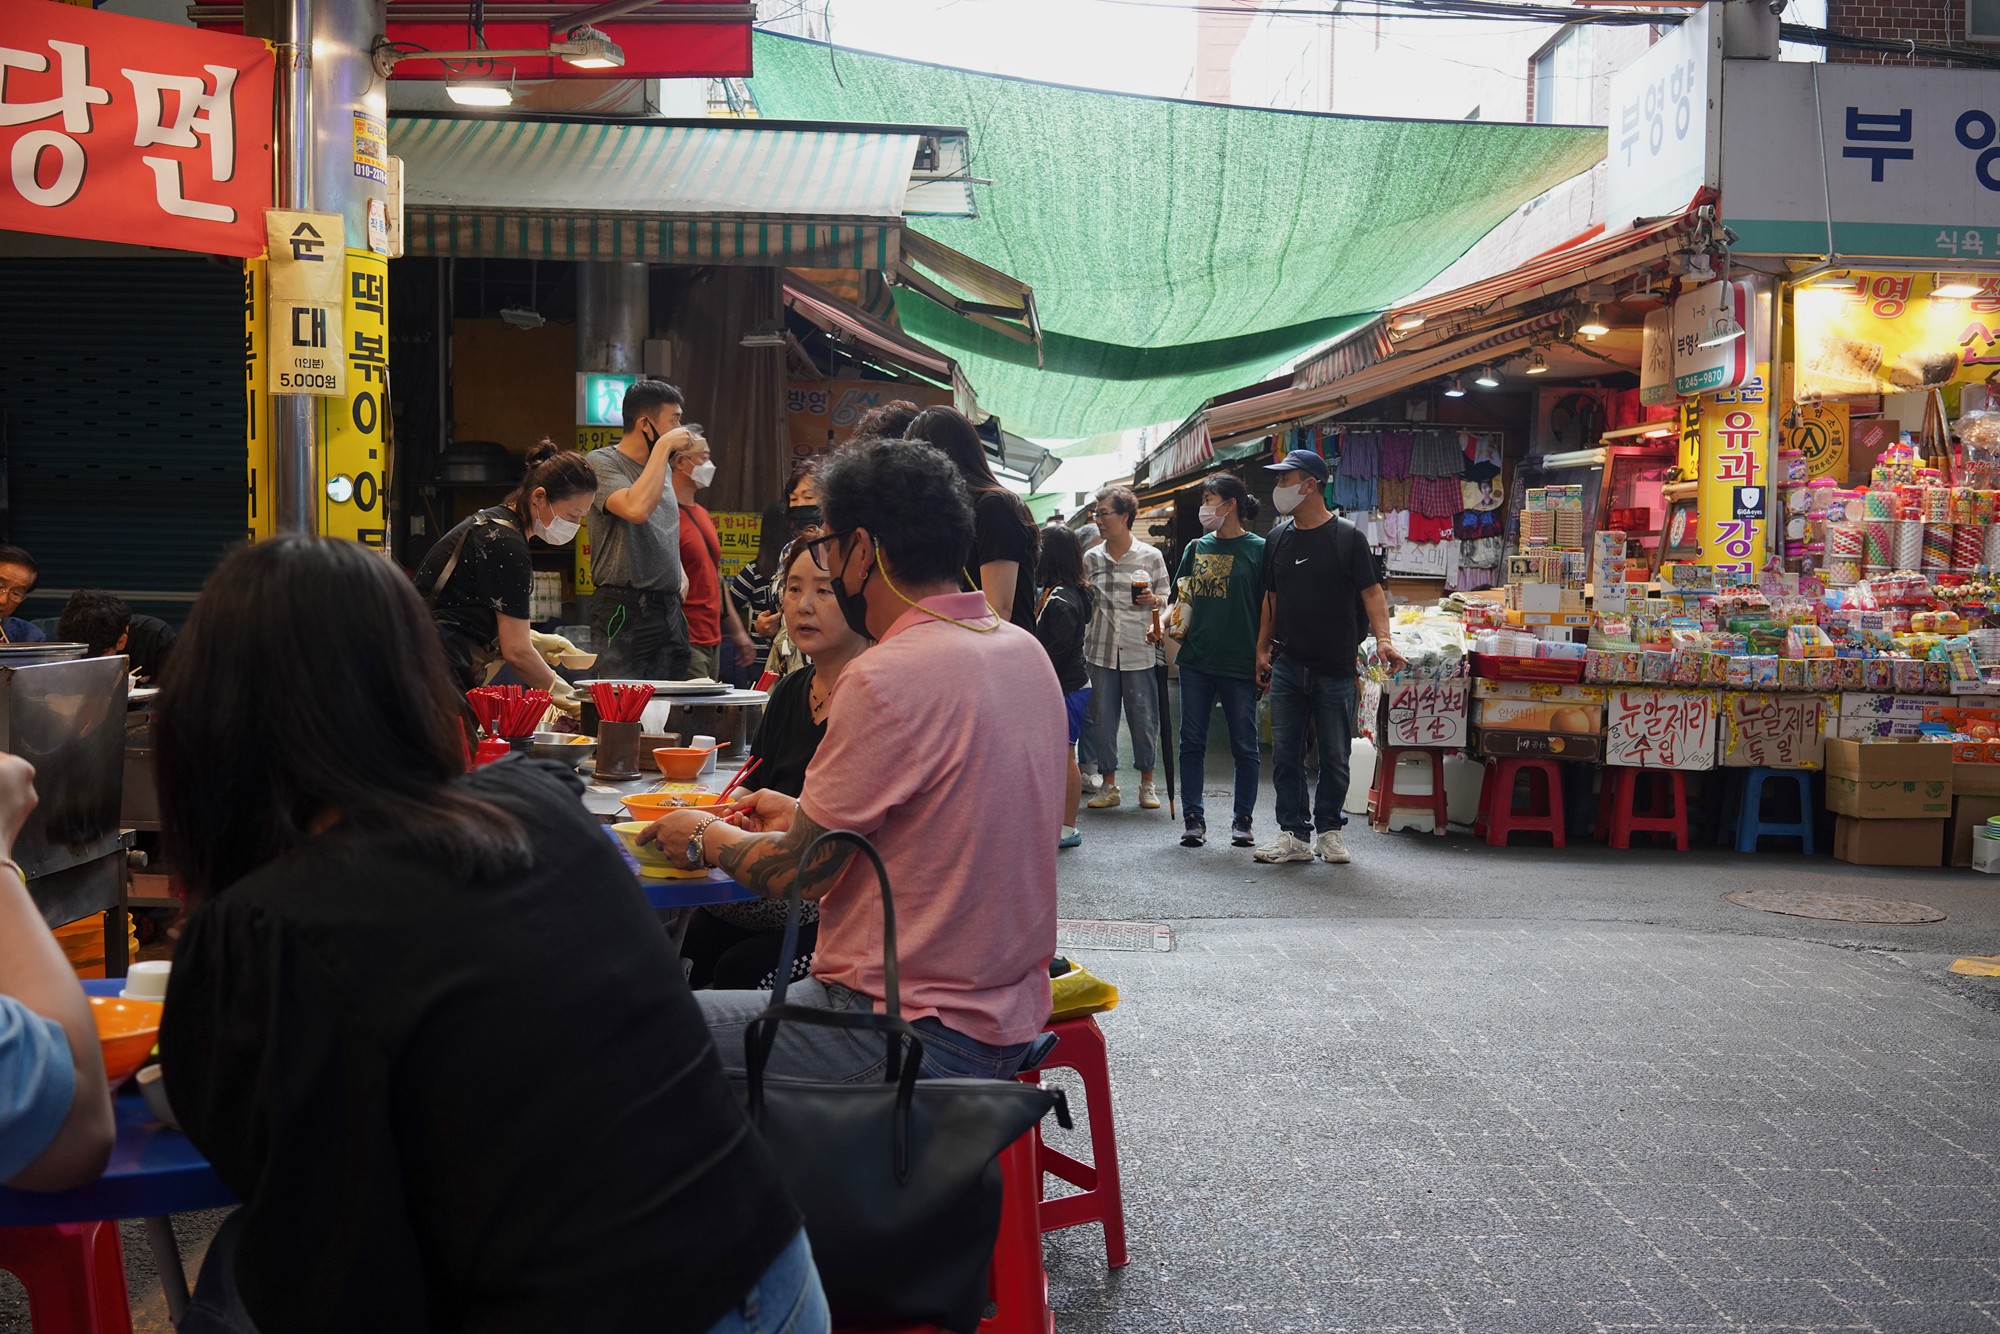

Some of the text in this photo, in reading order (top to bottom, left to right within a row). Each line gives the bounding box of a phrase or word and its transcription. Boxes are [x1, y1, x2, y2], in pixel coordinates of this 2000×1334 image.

[1621, 59, 1695, 167] 부영향
[0, 40, 238, 223] 당면
[1936, 230, 1984, 256] 식육
[289, 222, 328, 348] 순대
[294, 358, 324, 369] (1인분)
[1685, 369, 1722, 387] 245-9870
[788, 389, 827, 415] 방영
[1392, 685, 1468, 719] 새싹보리
[1498, 707, 1537, 723] 안성배
[1400, 716, 1446, 744] 국산
[1618, 692, 1709, 749] 눈알제리
[1735, 697, 1821, 746] 눈알제리
[1624, 732, 1675, 767] 수입
[1749, 733, 1792, 765] 독일
